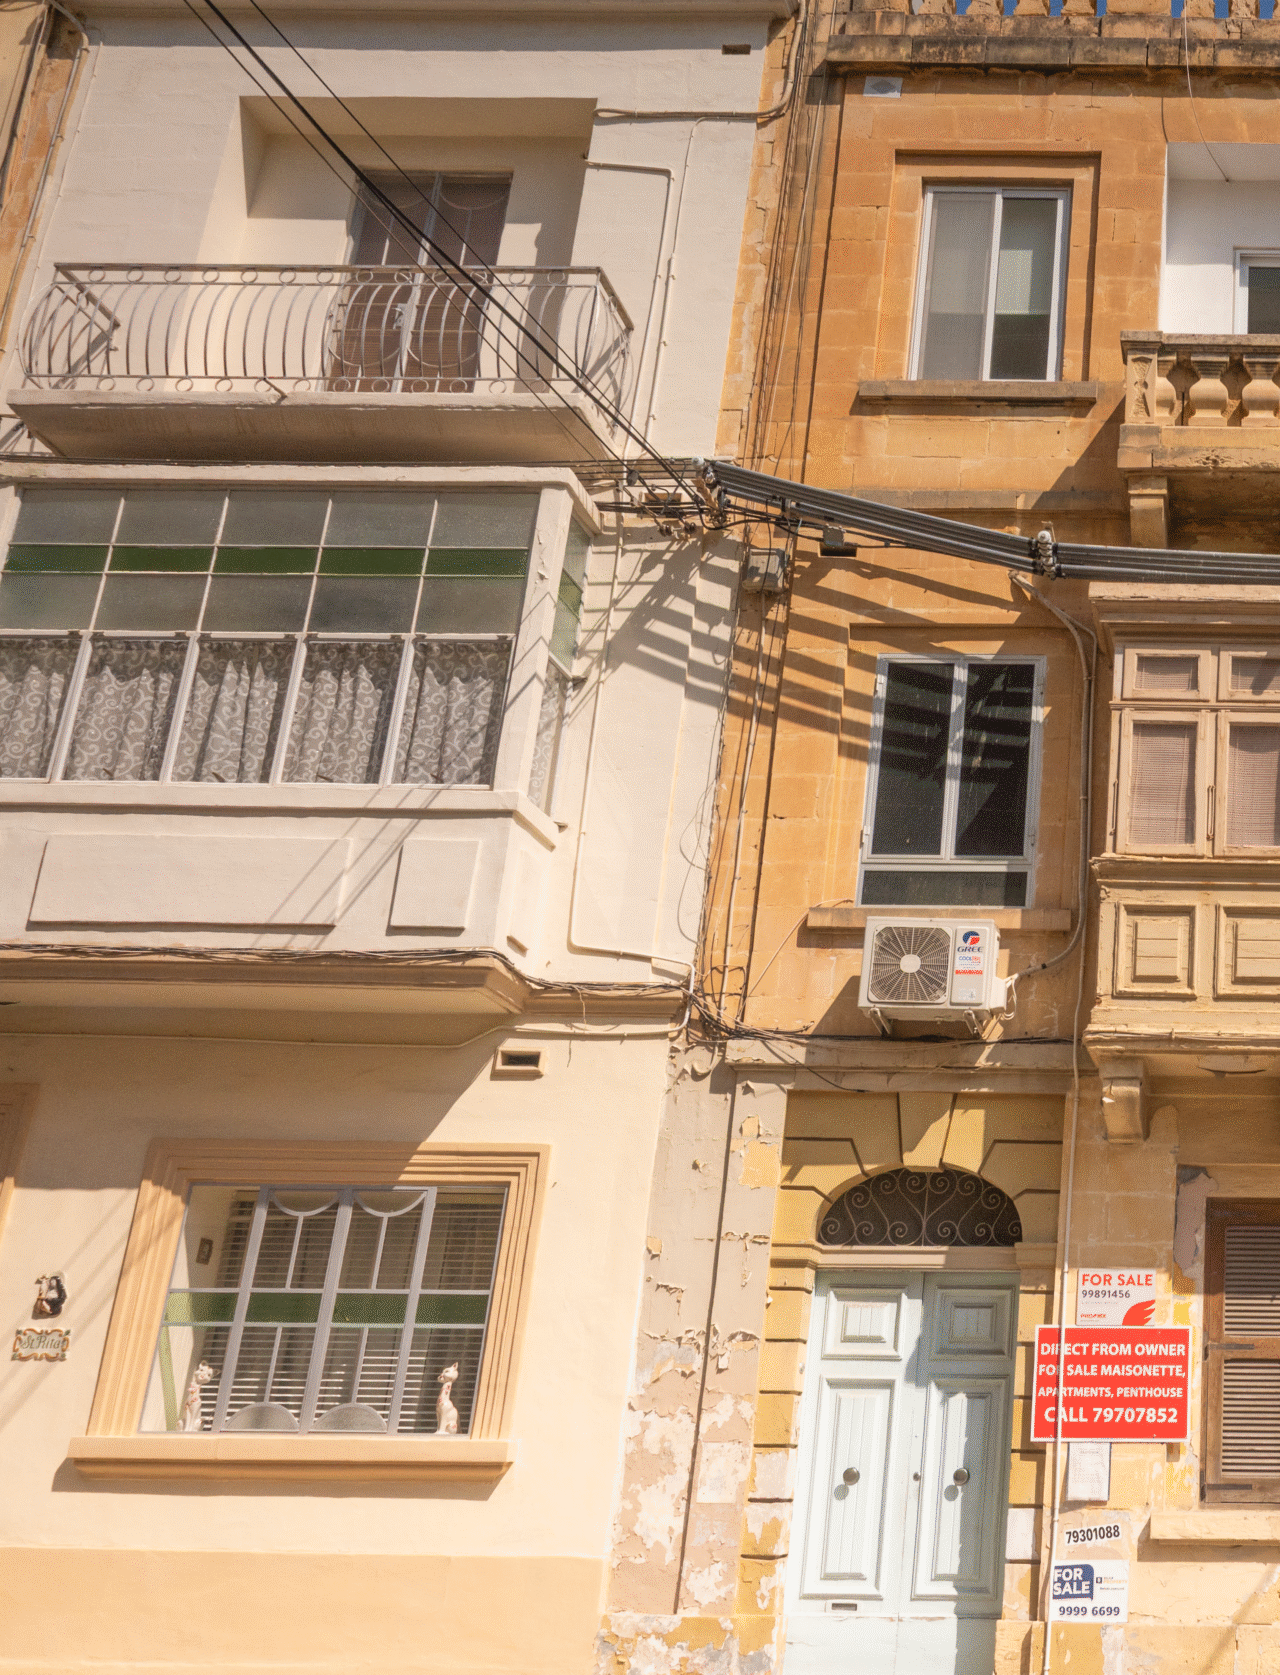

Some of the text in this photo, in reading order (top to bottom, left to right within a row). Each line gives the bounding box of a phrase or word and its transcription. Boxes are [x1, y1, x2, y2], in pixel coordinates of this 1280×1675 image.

[1082, 1273, 1153, 1286] FOR SALE
[1082, 1290, 1131, 1299] 99891456
[1092, 1343, 1132, 1356] FROM
[1134, 1343, 1186, 1356] OWNER
[1066, 1364, 1097, 1376] SALE
[1100, 1364, 1186, 1378] MAISONETTE,
[1038, 1386, 1183, 1398] APARTMENTS, PENTHOUSE
[1044, 1406, 1178, 1423] CALL 79707852
[1066, 1525, 1120, 1544] 79301088
[1053, 1567, 1090, 1595] FOR SALE
[1059, 1606, 1120, 1616] 9999 6699
